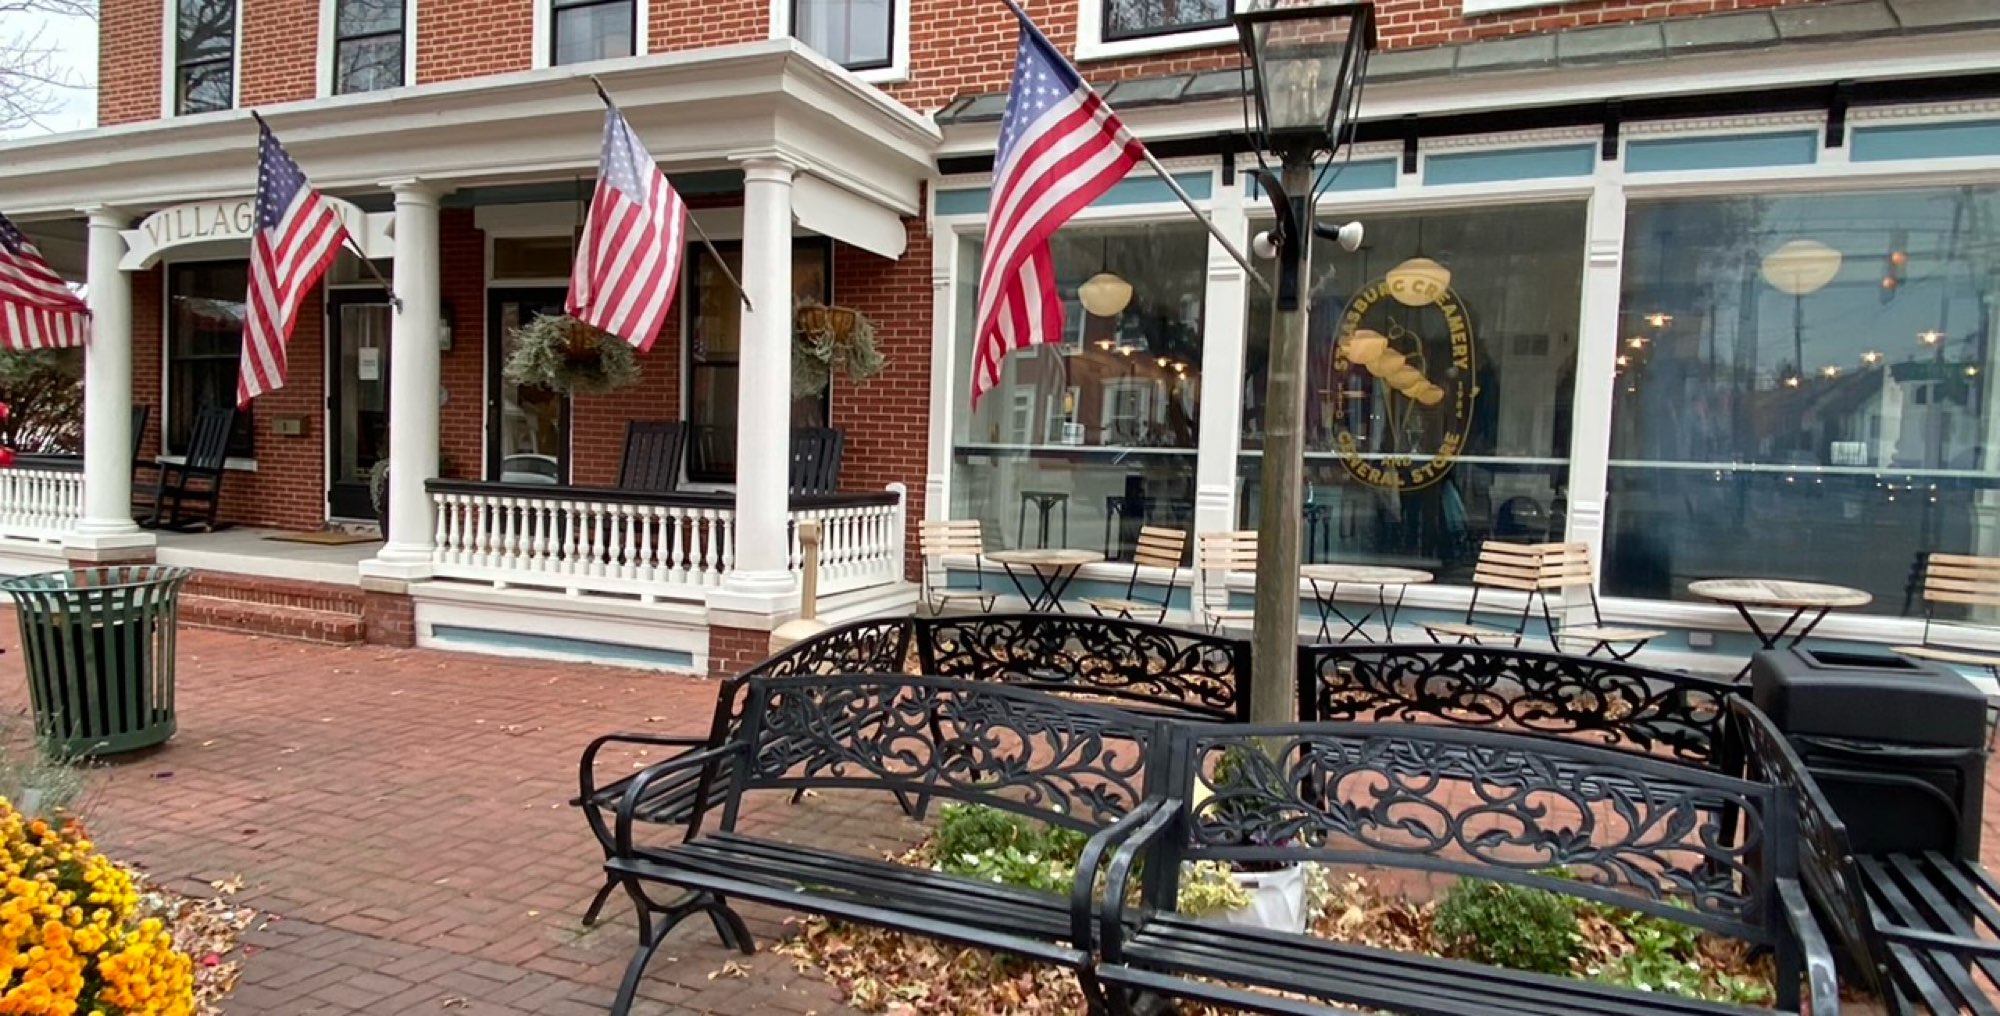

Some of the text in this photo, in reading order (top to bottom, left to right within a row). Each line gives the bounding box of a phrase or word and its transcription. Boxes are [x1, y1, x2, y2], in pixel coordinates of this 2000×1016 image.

[146, 201, 252, 247] VILLAG
[1412, 280, 1468, 370] CREAMERY
[1411, 432, 1460, 484] STORE
